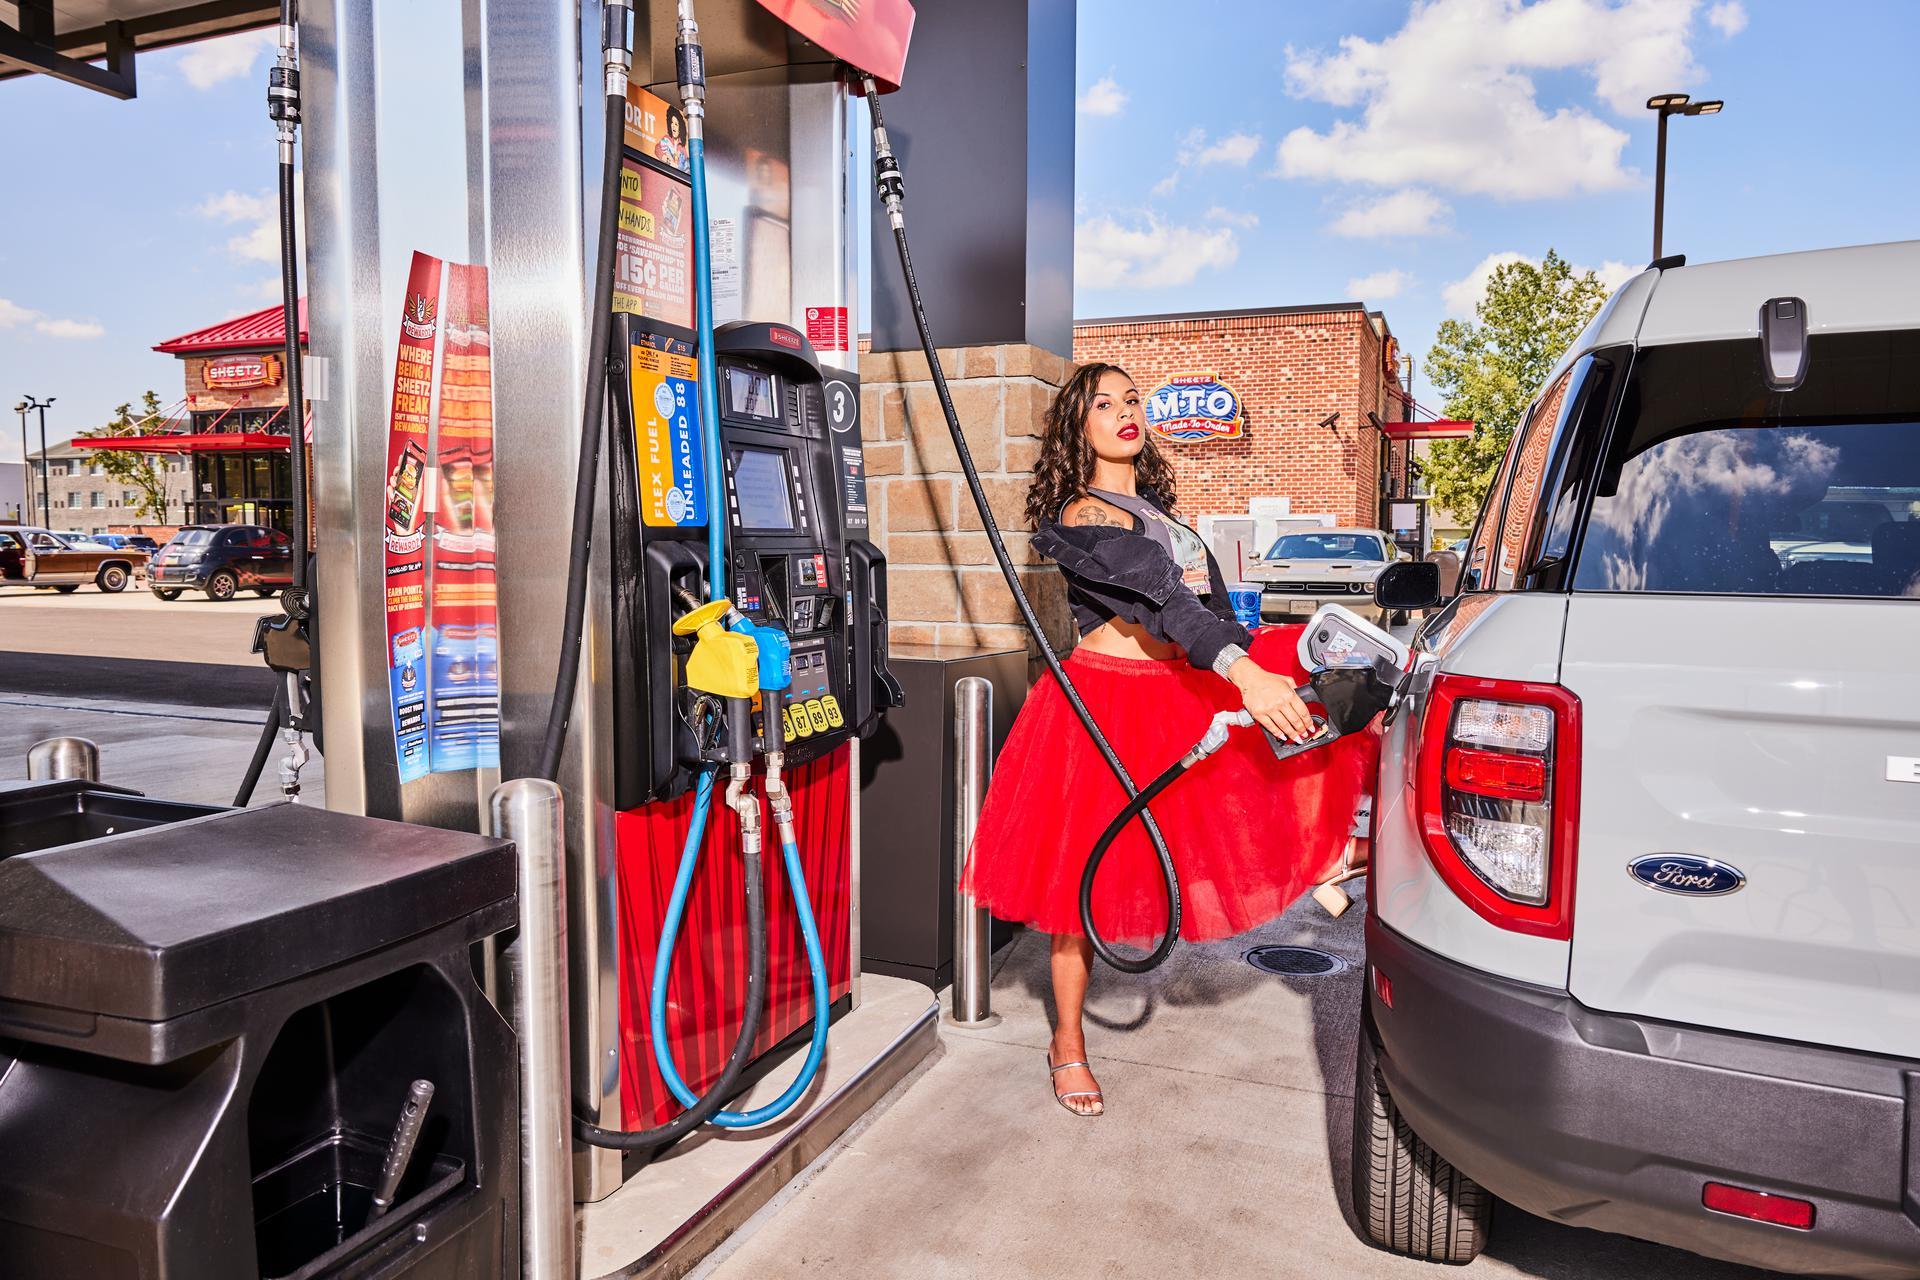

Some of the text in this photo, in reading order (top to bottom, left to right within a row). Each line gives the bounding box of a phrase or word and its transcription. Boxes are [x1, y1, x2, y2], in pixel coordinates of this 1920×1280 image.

[644, 112, 656, 135] IT
[625, 210, 653, 233] HANDS.
[621, 253, 657, 289] 15¢
[660, 264, 684, 287] PER
[626, 298, 638, 310] APP
[400, 344, 433, 366] WHERE
[210, 365, 262, 379] SHEETZ
[398, 361, 431, 381] BEING A
[1172, 376, 1211, 384] SHEETZ
[397, 376, 431, 397] SHEETZ
[675, 382, 686, 408] 88
[395, 393, 429, 415] FREAK
[833, 391, 845, 423] 3
[647, 417, 665, 519] FLEX FUEL
[678, 415, 696, 520] UNLEADED
[390, 539, 420, 552] REWARDZ
[795, 715, 807, 729] 87
[812, 711, 823, 724] 89
[827, 707, 839, 720] 93
[1653, 862, 1717, 889] Ford
